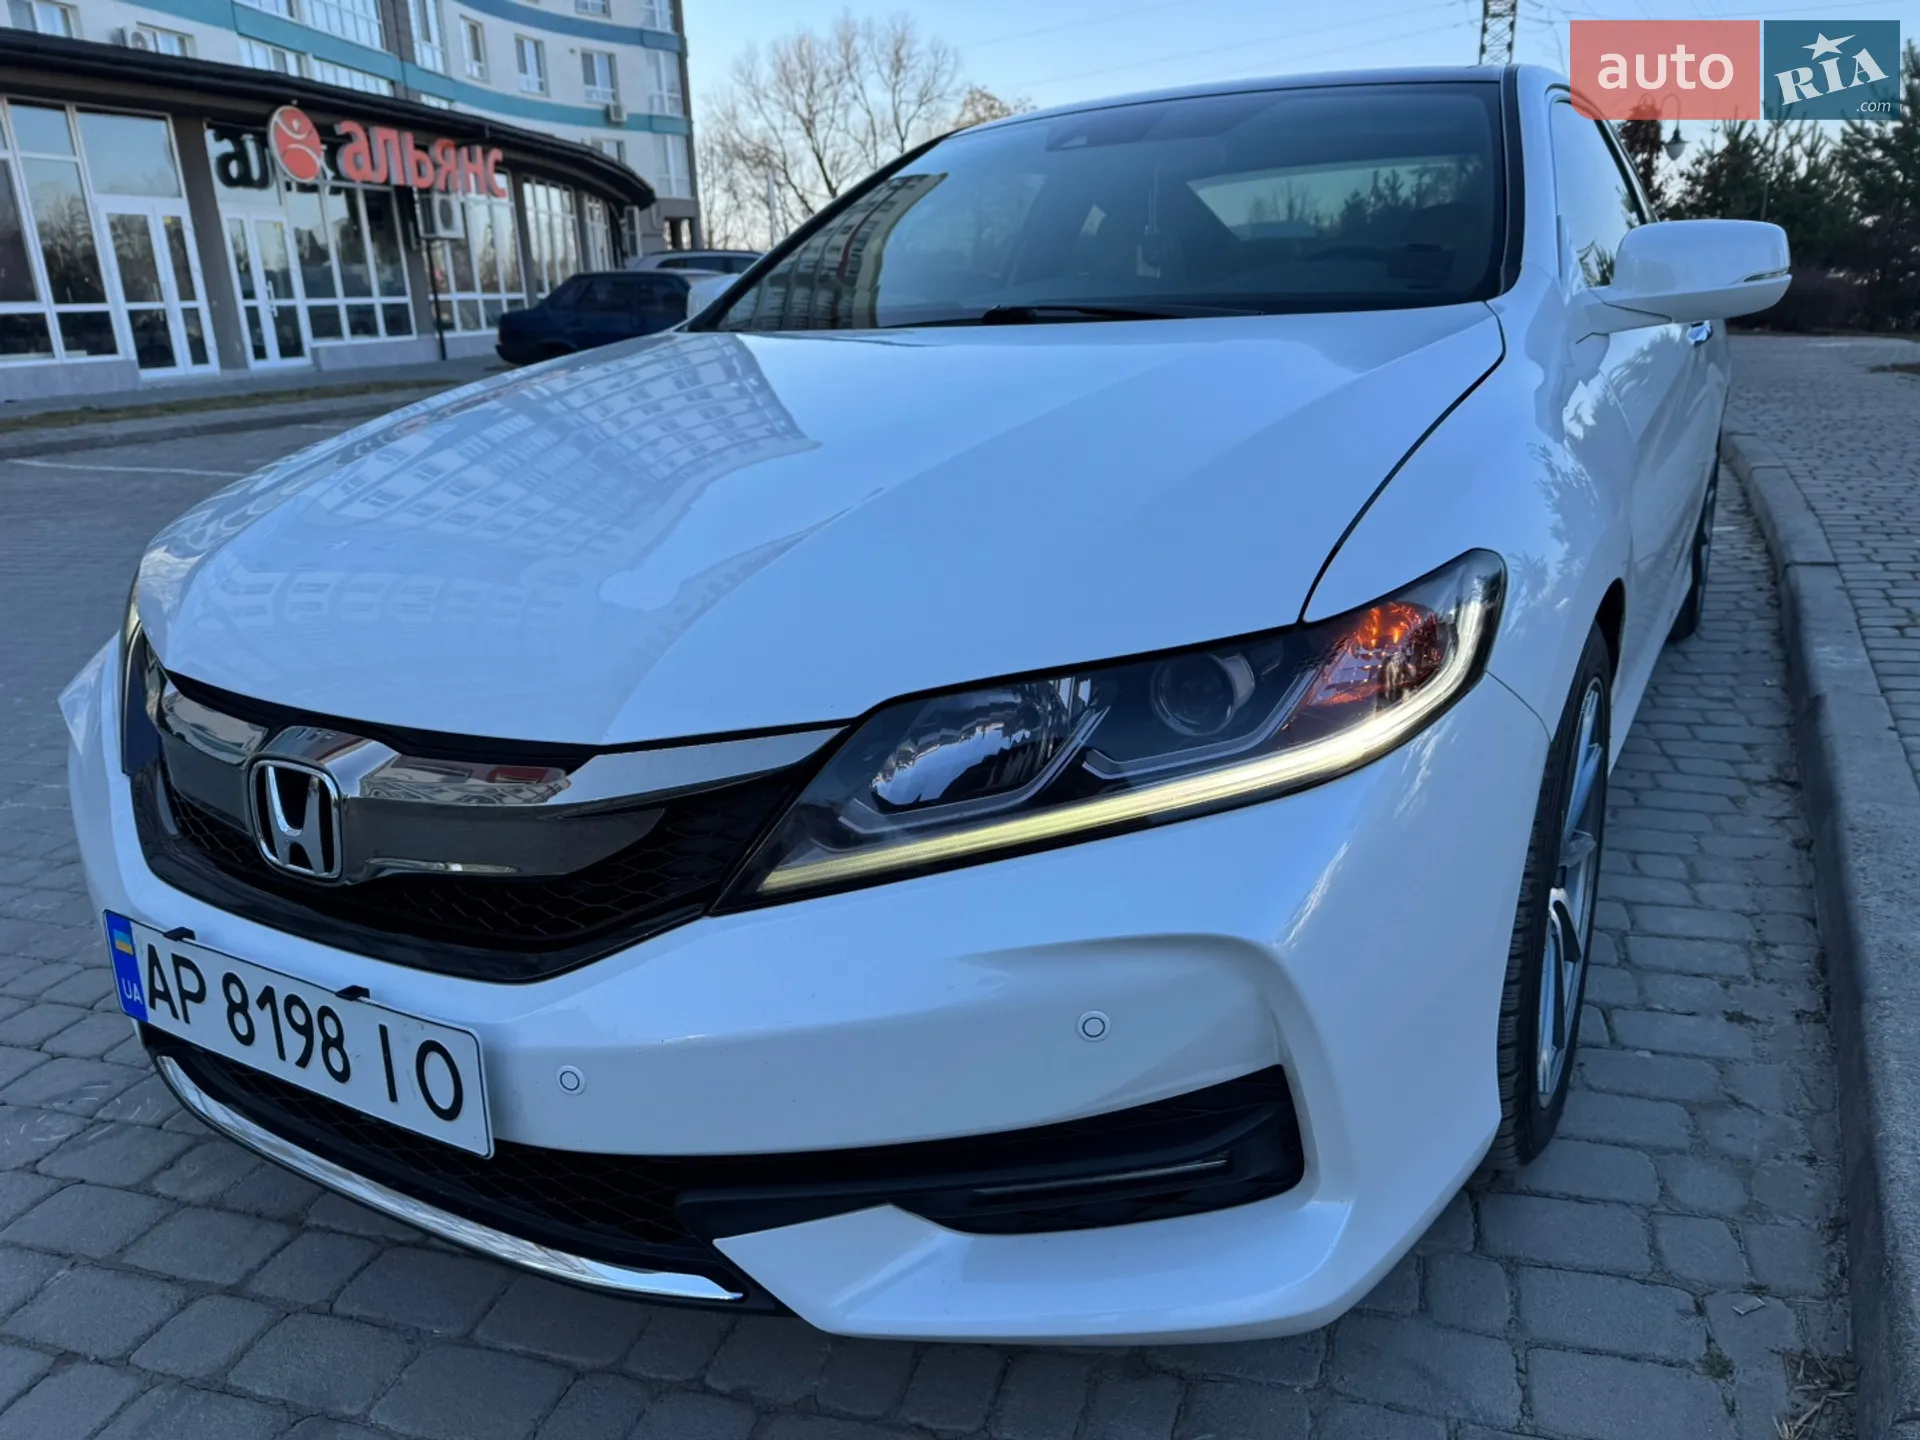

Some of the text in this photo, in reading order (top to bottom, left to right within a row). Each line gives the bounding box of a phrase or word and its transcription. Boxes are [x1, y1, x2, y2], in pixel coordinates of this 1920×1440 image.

[121, 977, 144, 1005] UA
[147, 943, 207, 1025] AP
[222, 972, 352, 1084] 8198
